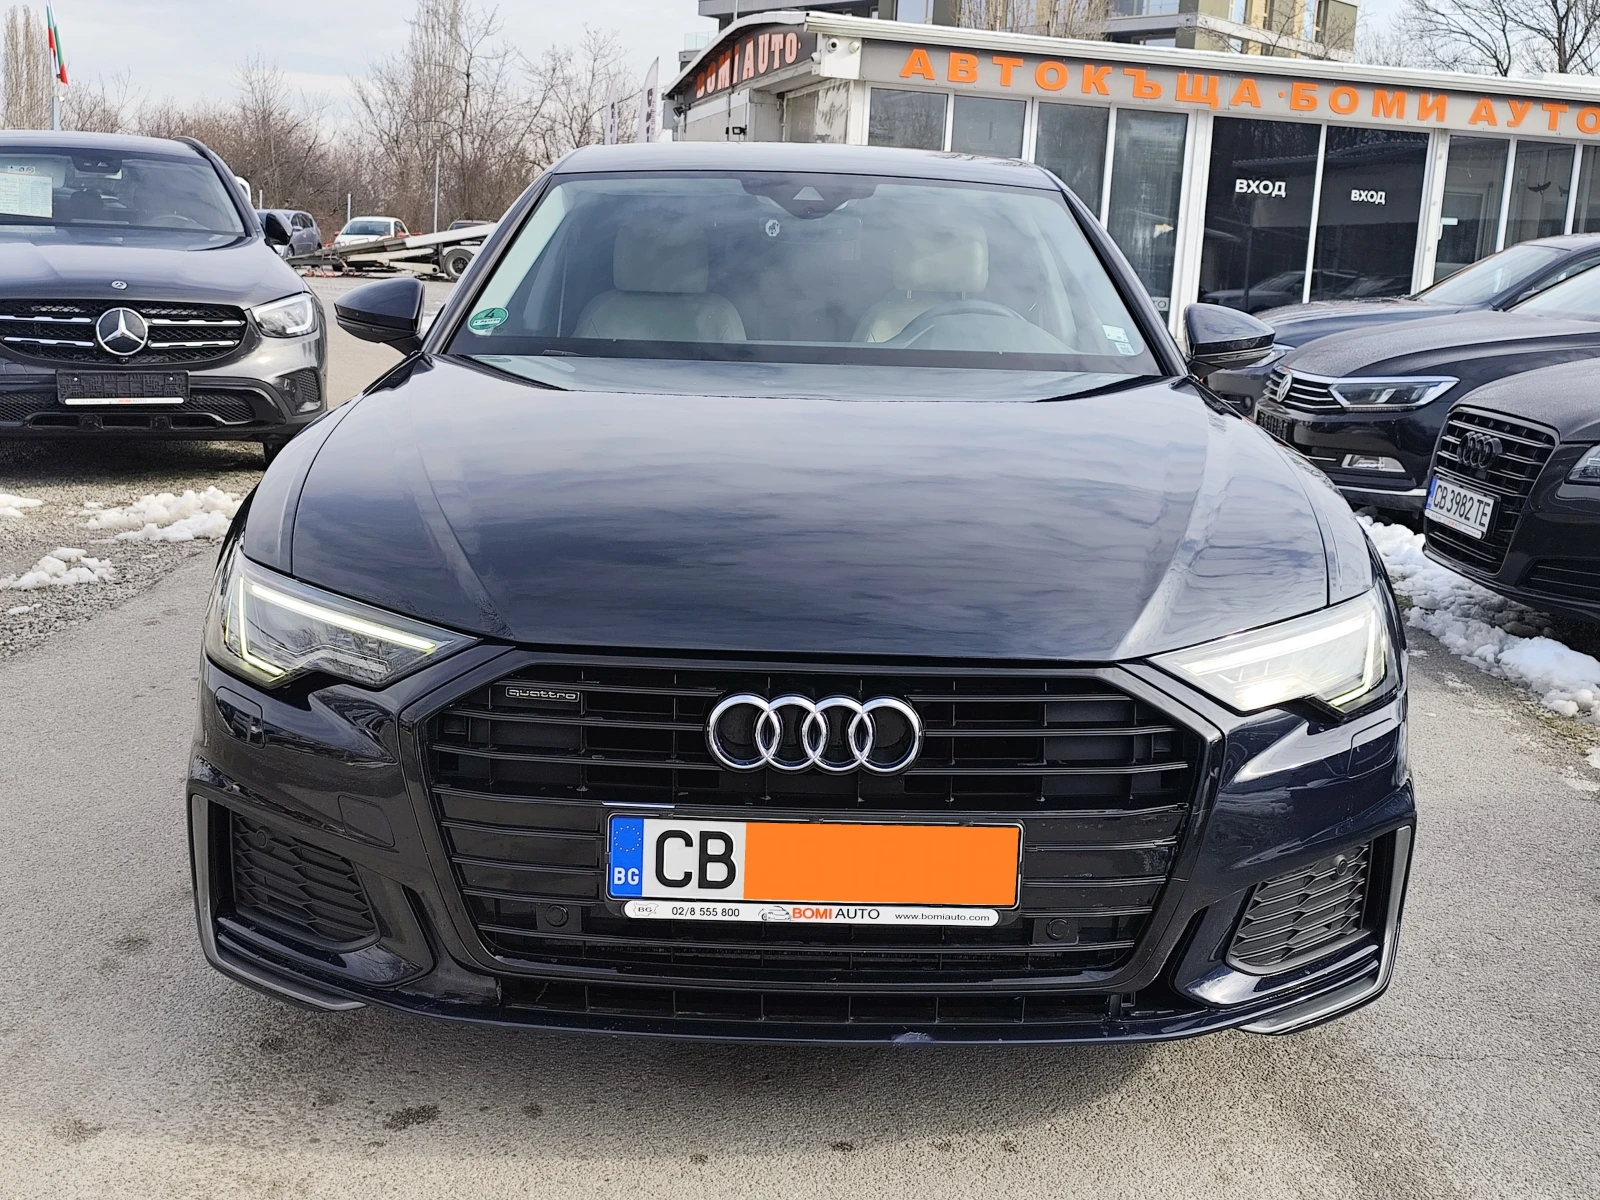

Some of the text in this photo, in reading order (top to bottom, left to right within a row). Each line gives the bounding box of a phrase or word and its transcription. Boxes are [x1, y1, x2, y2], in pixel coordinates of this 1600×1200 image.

[695, 32, 798, 98] BOMI AUTO
[899, 48, 1600, 134] АВТОКЪЩА БОМИ АУТО
[1235, 178, 1287, 198] ВХОД
[1350, 189, 1386, 205] ВХОД
[1433, 484, 1449, 510] CB
[1446, 489, 1475, 522] 3982
[1474, 498, 1491, 528] TE
[508, 689, 576, 699] quattro
[655, 829, 737, 889] CB
[613, 867, 640, 885] BG
[671, 906, 740, 917] 02/8 555 800
[792, 907, 880, 920] BOMI AUTO
[894, 912, 990, 922] www.bomiauto.com
